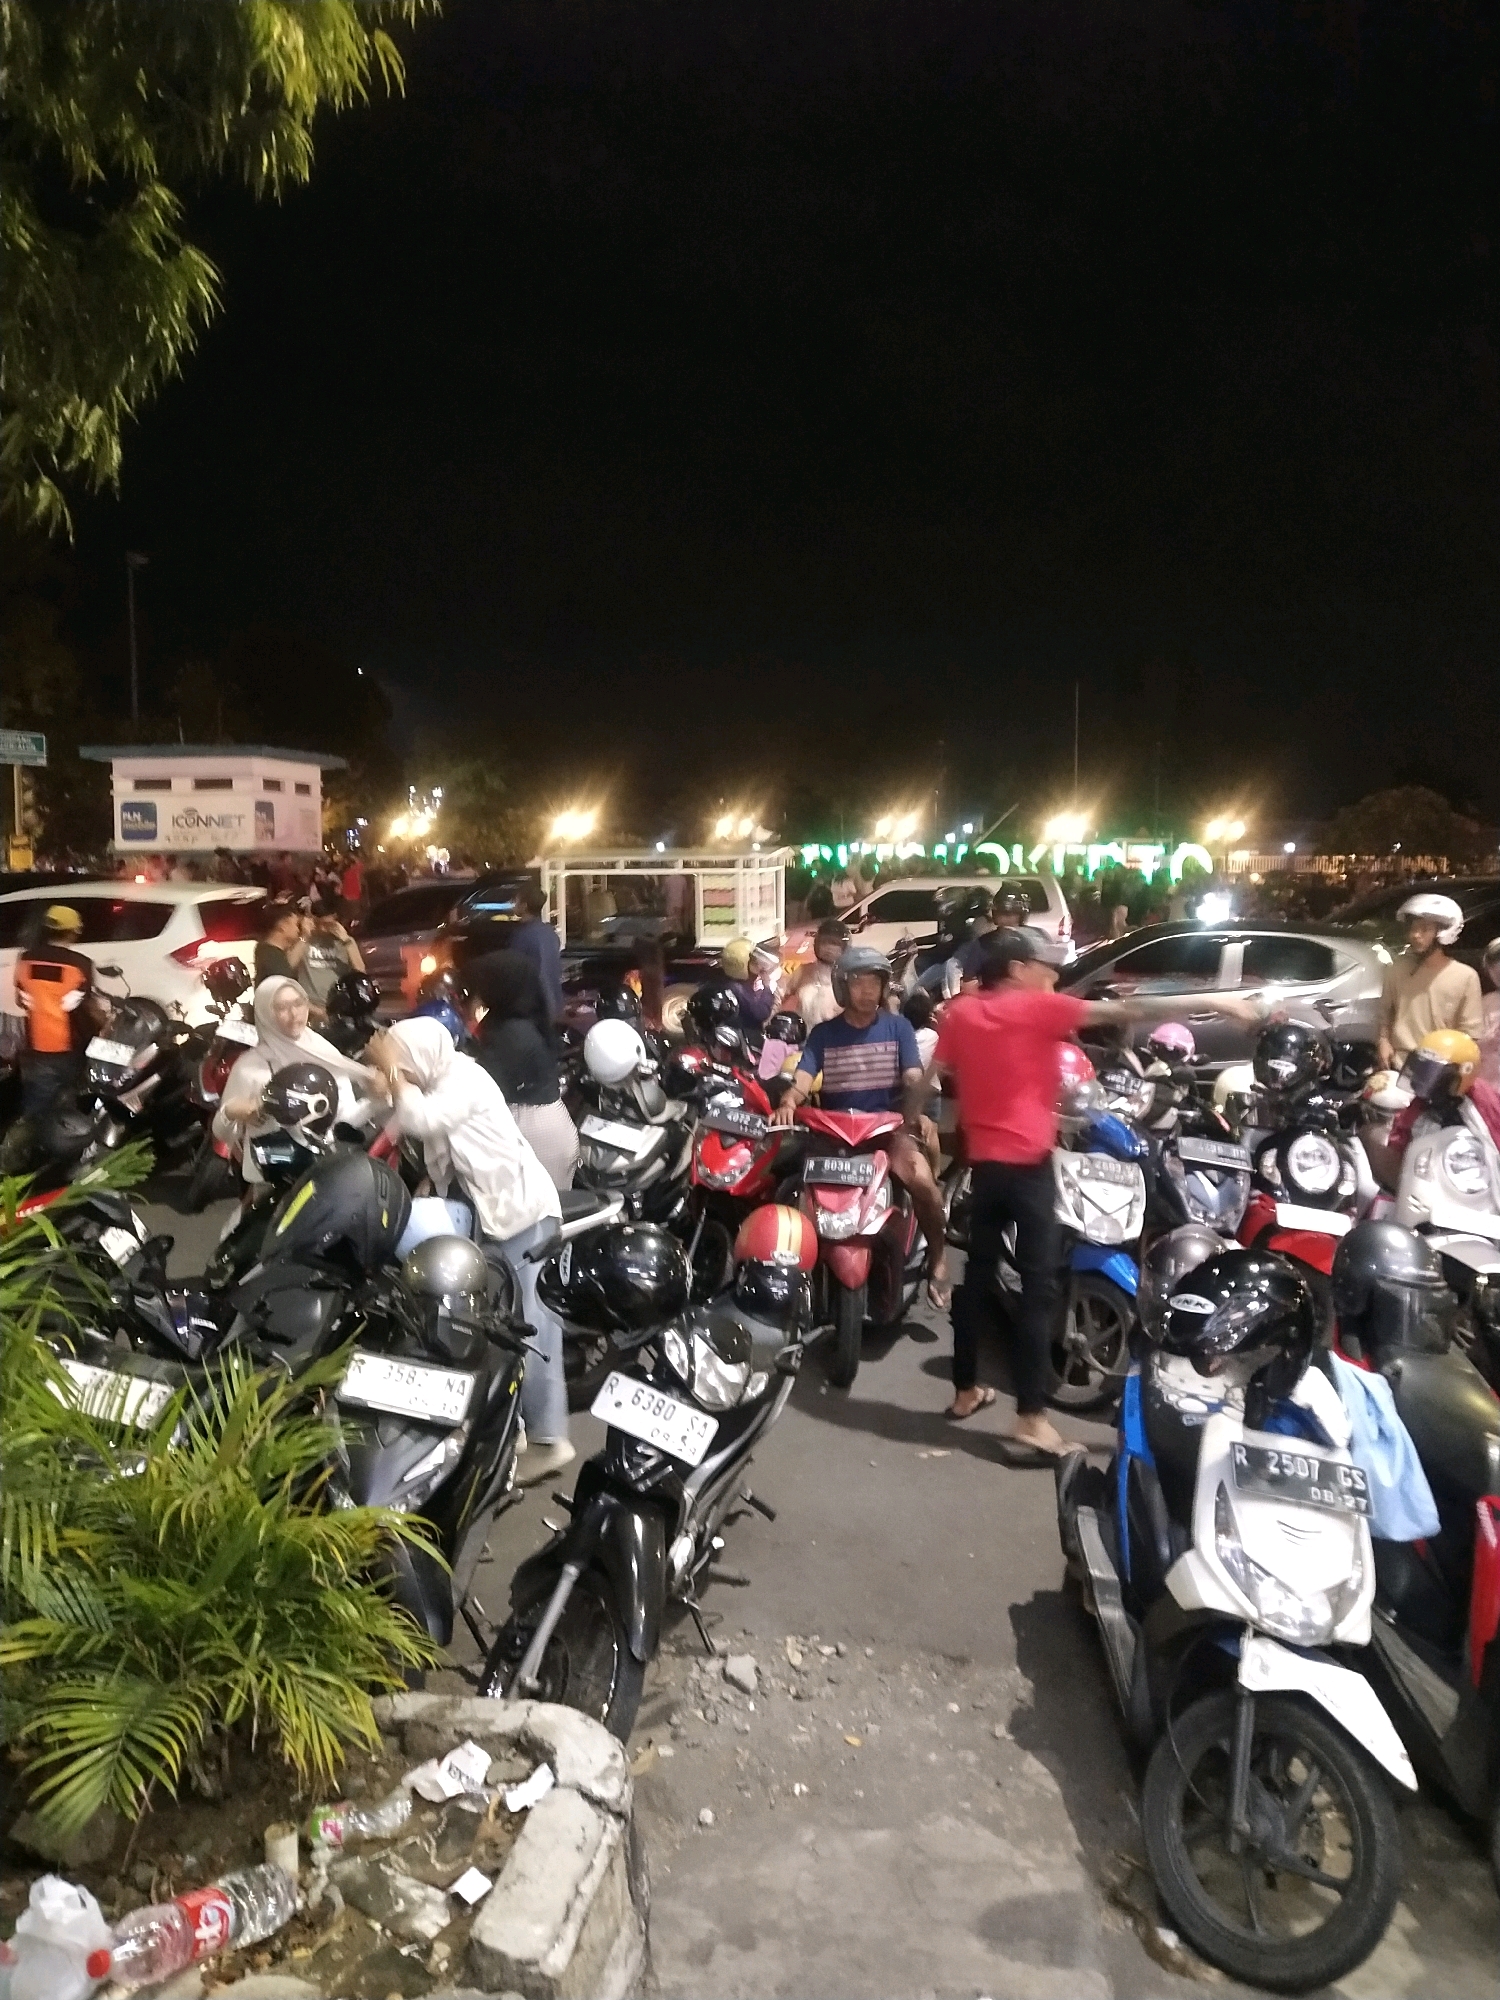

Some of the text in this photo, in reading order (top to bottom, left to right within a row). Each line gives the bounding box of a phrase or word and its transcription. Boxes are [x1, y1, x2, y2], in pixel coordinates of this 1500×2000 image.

[171, 813, 246, 829] ICONNET
[444, 1378, 466, 1396] NA
[605, 1376, 619, 1395] R
[631, 1387, 677, 1422] 6380
[1234, 1444, 1249, 1466] R
[1267, 1451, 1320, 1482] 2507
